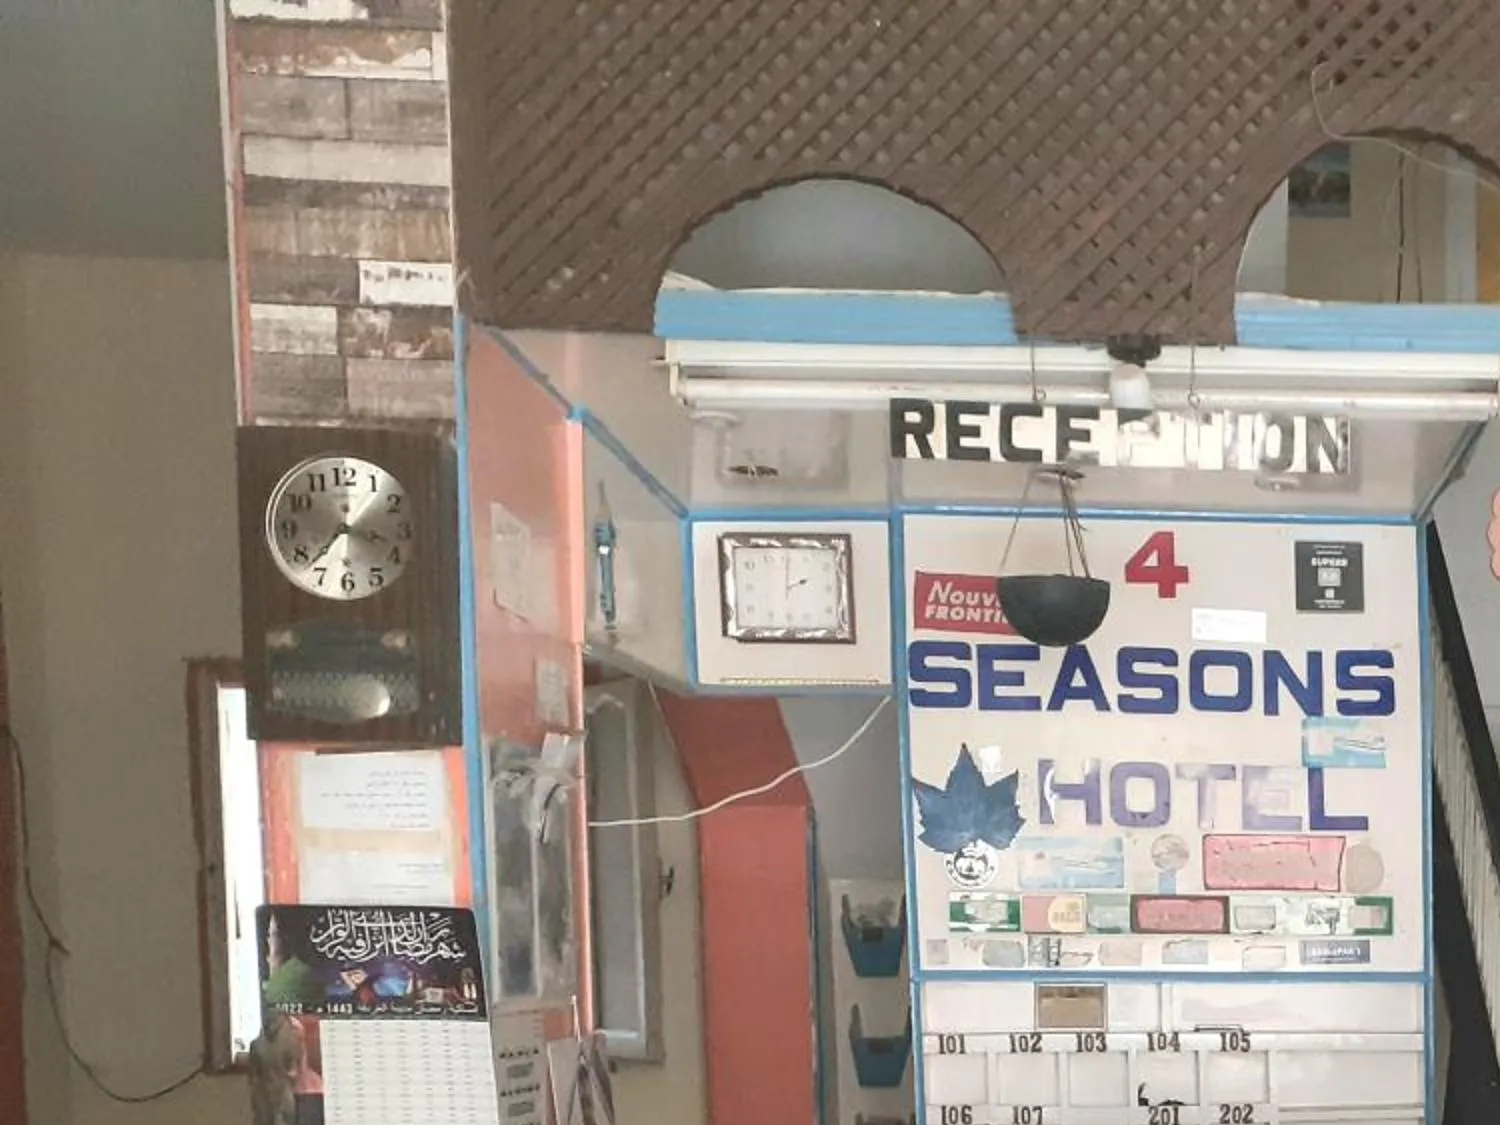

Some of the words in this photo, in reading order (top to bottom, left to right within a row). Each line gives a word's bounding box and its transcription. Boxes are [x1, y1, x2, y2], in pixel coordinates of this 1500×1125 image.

[308, 473, 327, 492] 11
[332, 467, 357, 487] 12
[368, 474, 378, 492] 1
[286, 493, 312, 513] 10
[387, 493, 401, 513] 2
[281, 519, 298, 539] 9
[396, 522, 412, 540] 3
[293, 544, 309, 563] 8
[387, 545, 401, 565] 4
[1124, 530, 1189, 599] 4
[313, 566, 328, 586] 7
[340, 572, 356, 592] 6
[368, 567, 385, 587] 5
[908, 640, 1396, 717] SEASONS
[1037, 756, 1370, 833] HOTEL
[938, 1034, 968, 1055] 101
[1009, 1032, 1043, 1053] 102
[1075, 1032, 1107, 1053] 103
[1147, 1031, 1181, 1052] 104
[1219, 1031, 1251, 1052] 105
[940, 1105, 973, 1125] 106
[1012, 1105, 1044, 1125] 107
[1219, 1103, 1254, 1125] 202
